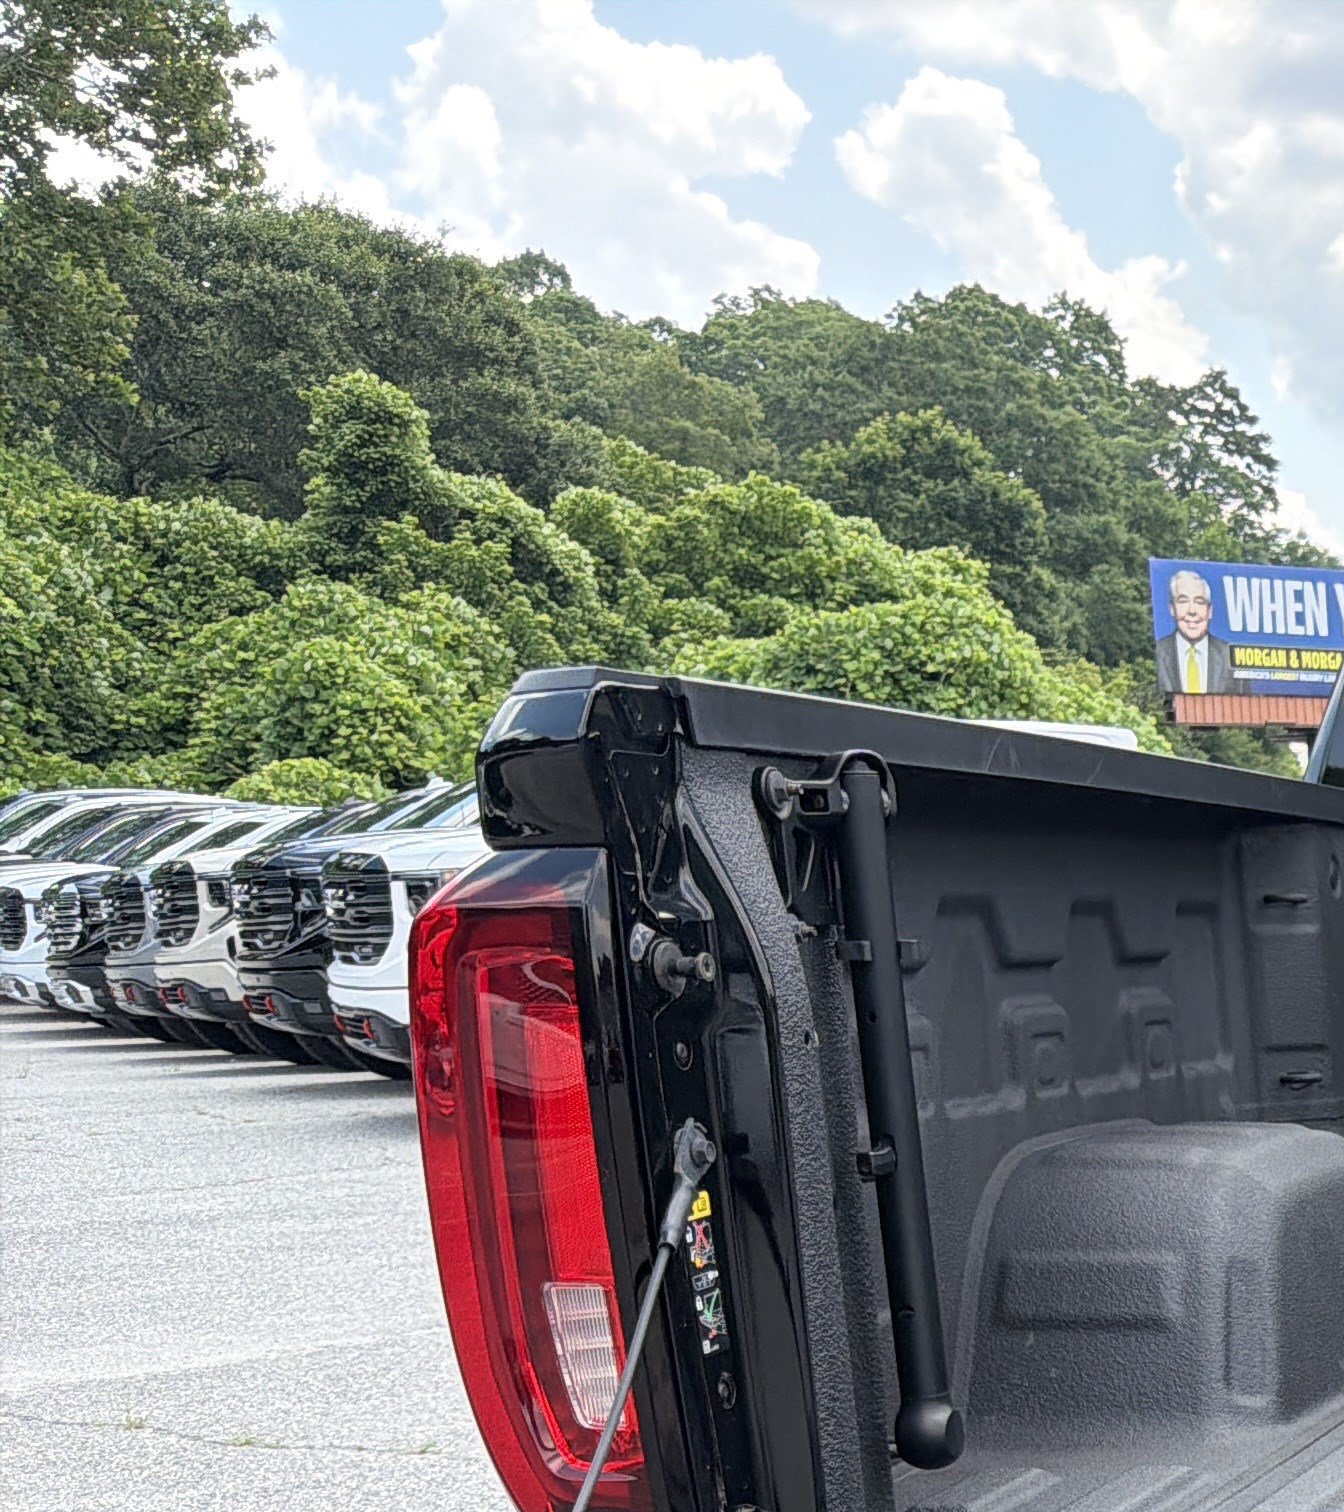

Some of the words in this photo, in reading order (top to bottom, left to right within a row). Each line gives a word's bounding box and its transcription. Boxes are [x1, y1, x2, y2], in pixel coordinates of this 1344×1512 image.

[1222, 575, 1329, 637] WHEN
[1234, 647, 1288, 668] MORGAN
[1289, 649, 1300, 669] &
